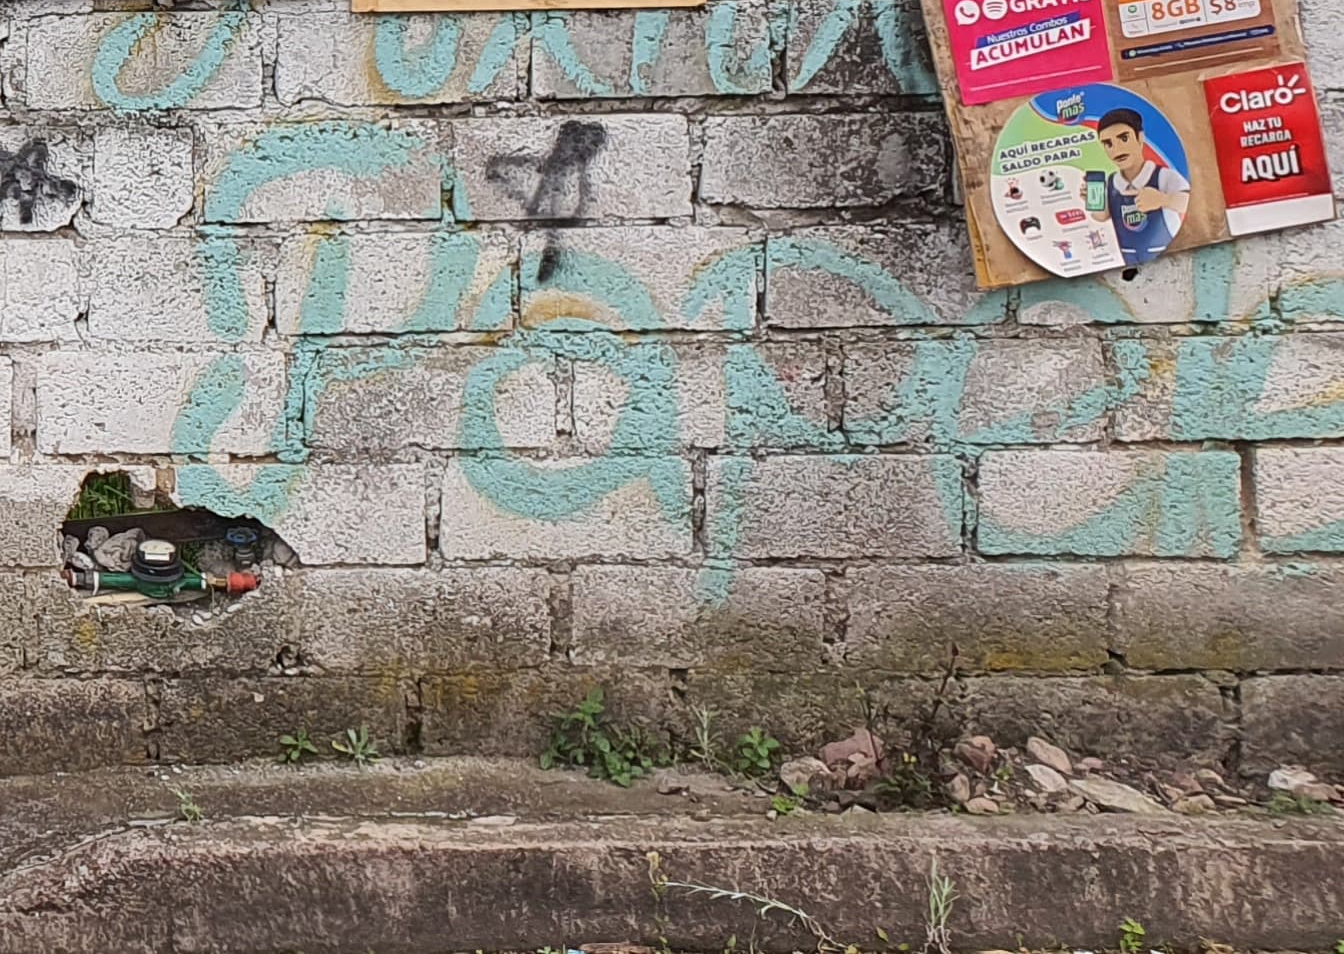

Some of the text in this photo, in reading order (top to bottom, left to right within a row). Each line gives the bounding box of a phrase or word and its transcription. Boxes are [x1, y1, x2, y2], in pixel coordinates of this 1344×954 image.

[975, 22, 1085, 66] ACUMULAN
[987, 16, 1069, 44] Nuestros Combos
[1220, 85, 1293, 114] Claro
[1243, 116, 1283, 133] HAZ TU
[1000, 131, 1095, 160] AQUÍ RECARGAS
[1240, 130, 1292, 148] RECARGA
[1002, 158, 1042, 173] SALDO
[1241, 144, 1300, 183] AQUÍ
